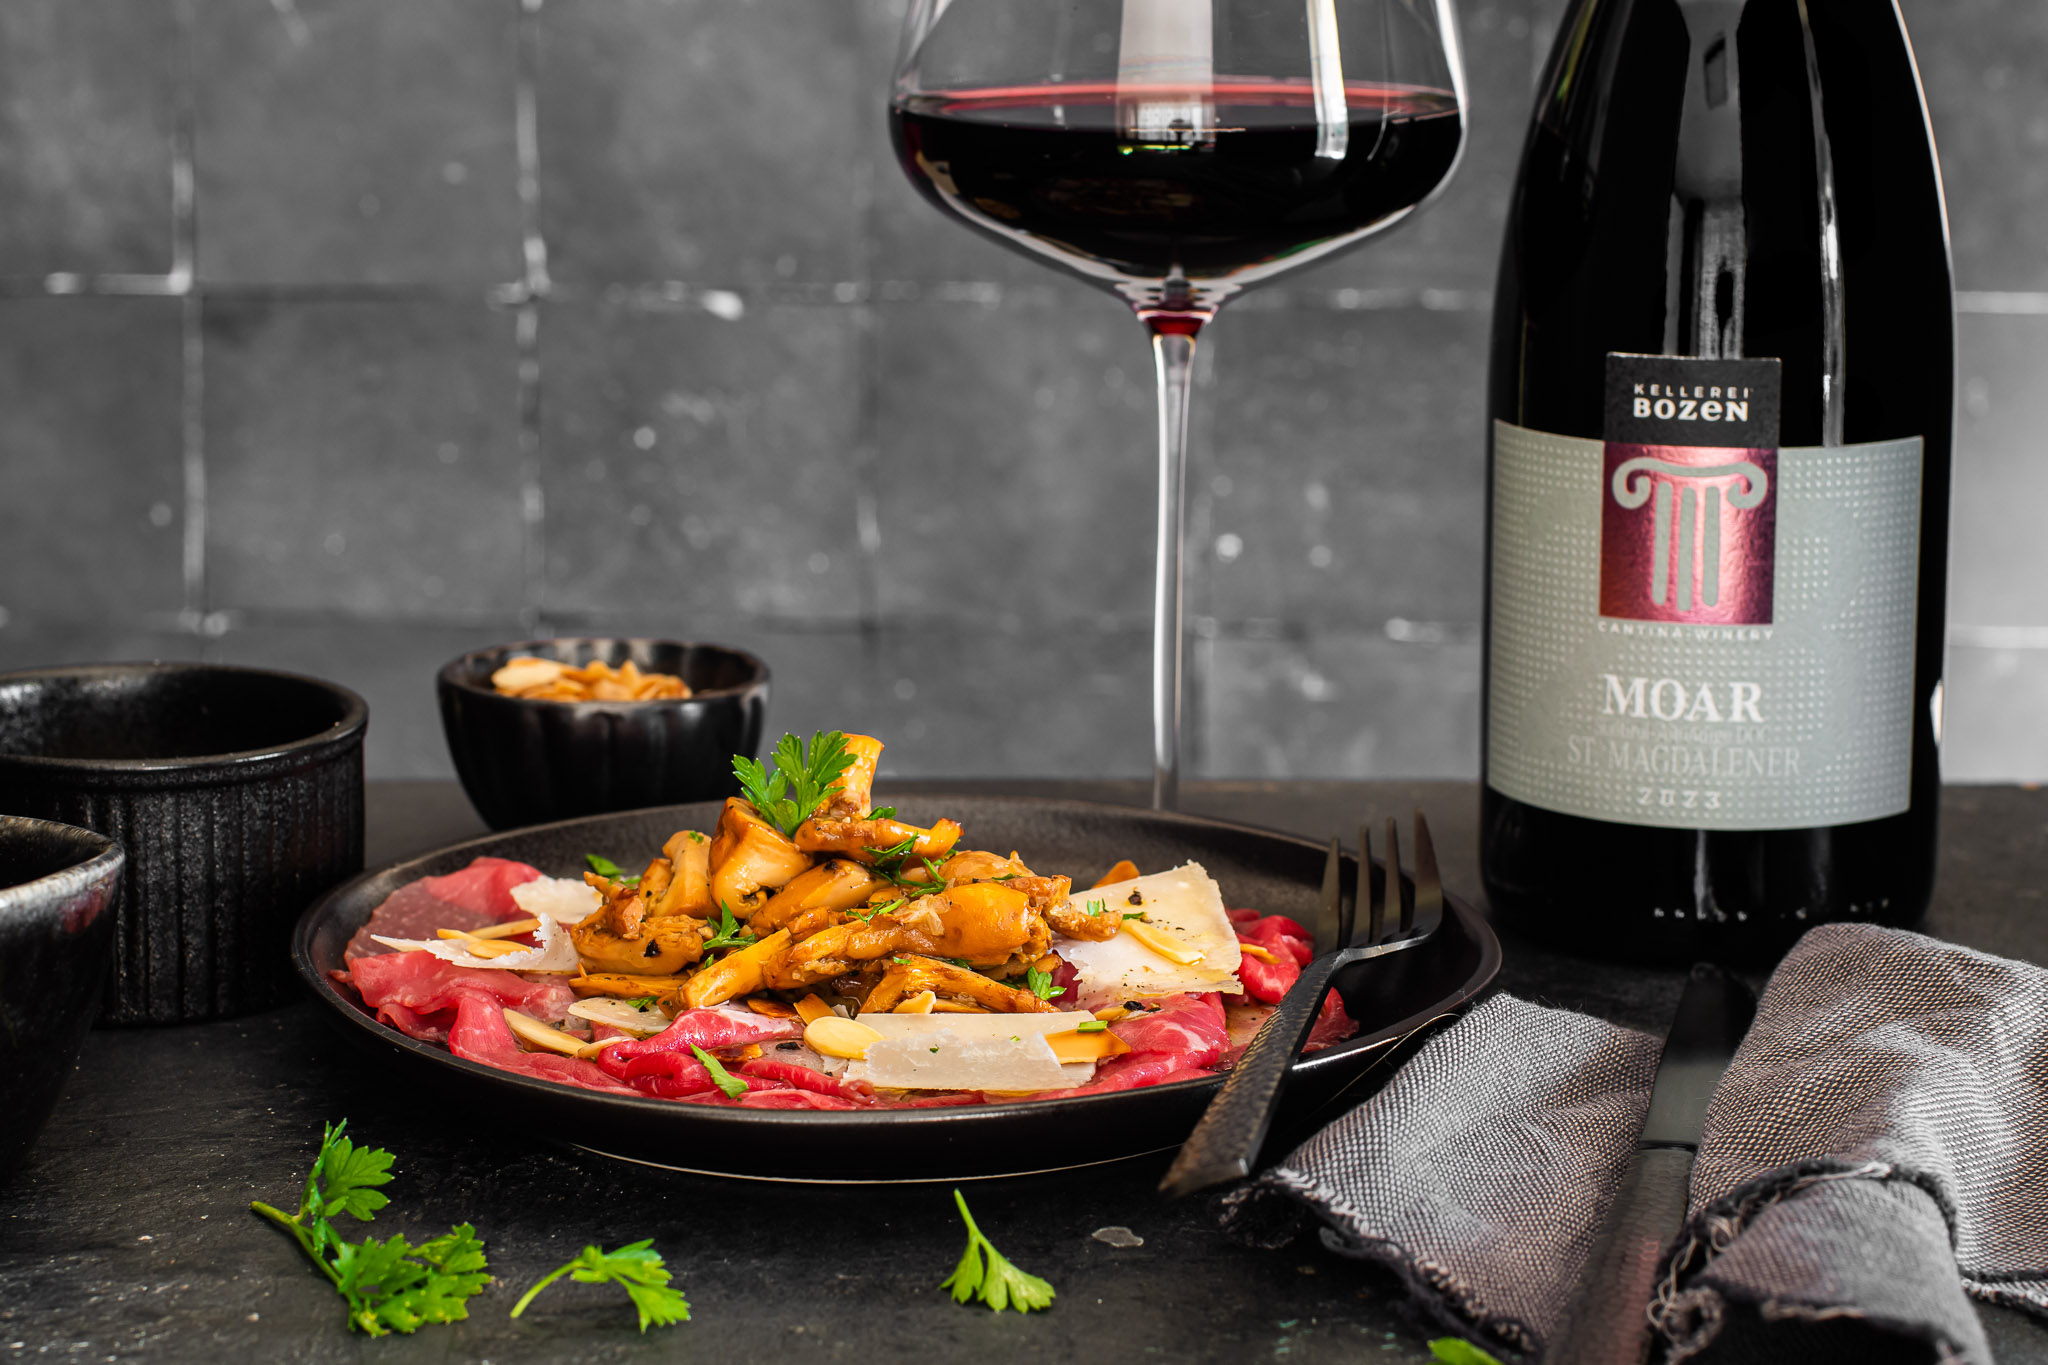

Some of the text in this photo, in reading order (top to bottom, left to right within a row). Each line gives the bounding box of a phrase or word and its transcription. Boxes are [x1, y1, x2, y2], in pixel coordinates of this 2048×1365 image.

[1633, 383, 1749, 399] KELLEREI
[1598, 620, 1774, 641] CANTINA WINERY
[1602, 673, 1765, 723] MOAR
[1607, 740, 1801, 777] MAGDALENER
[1637, 786, 1722, 810] 2023
